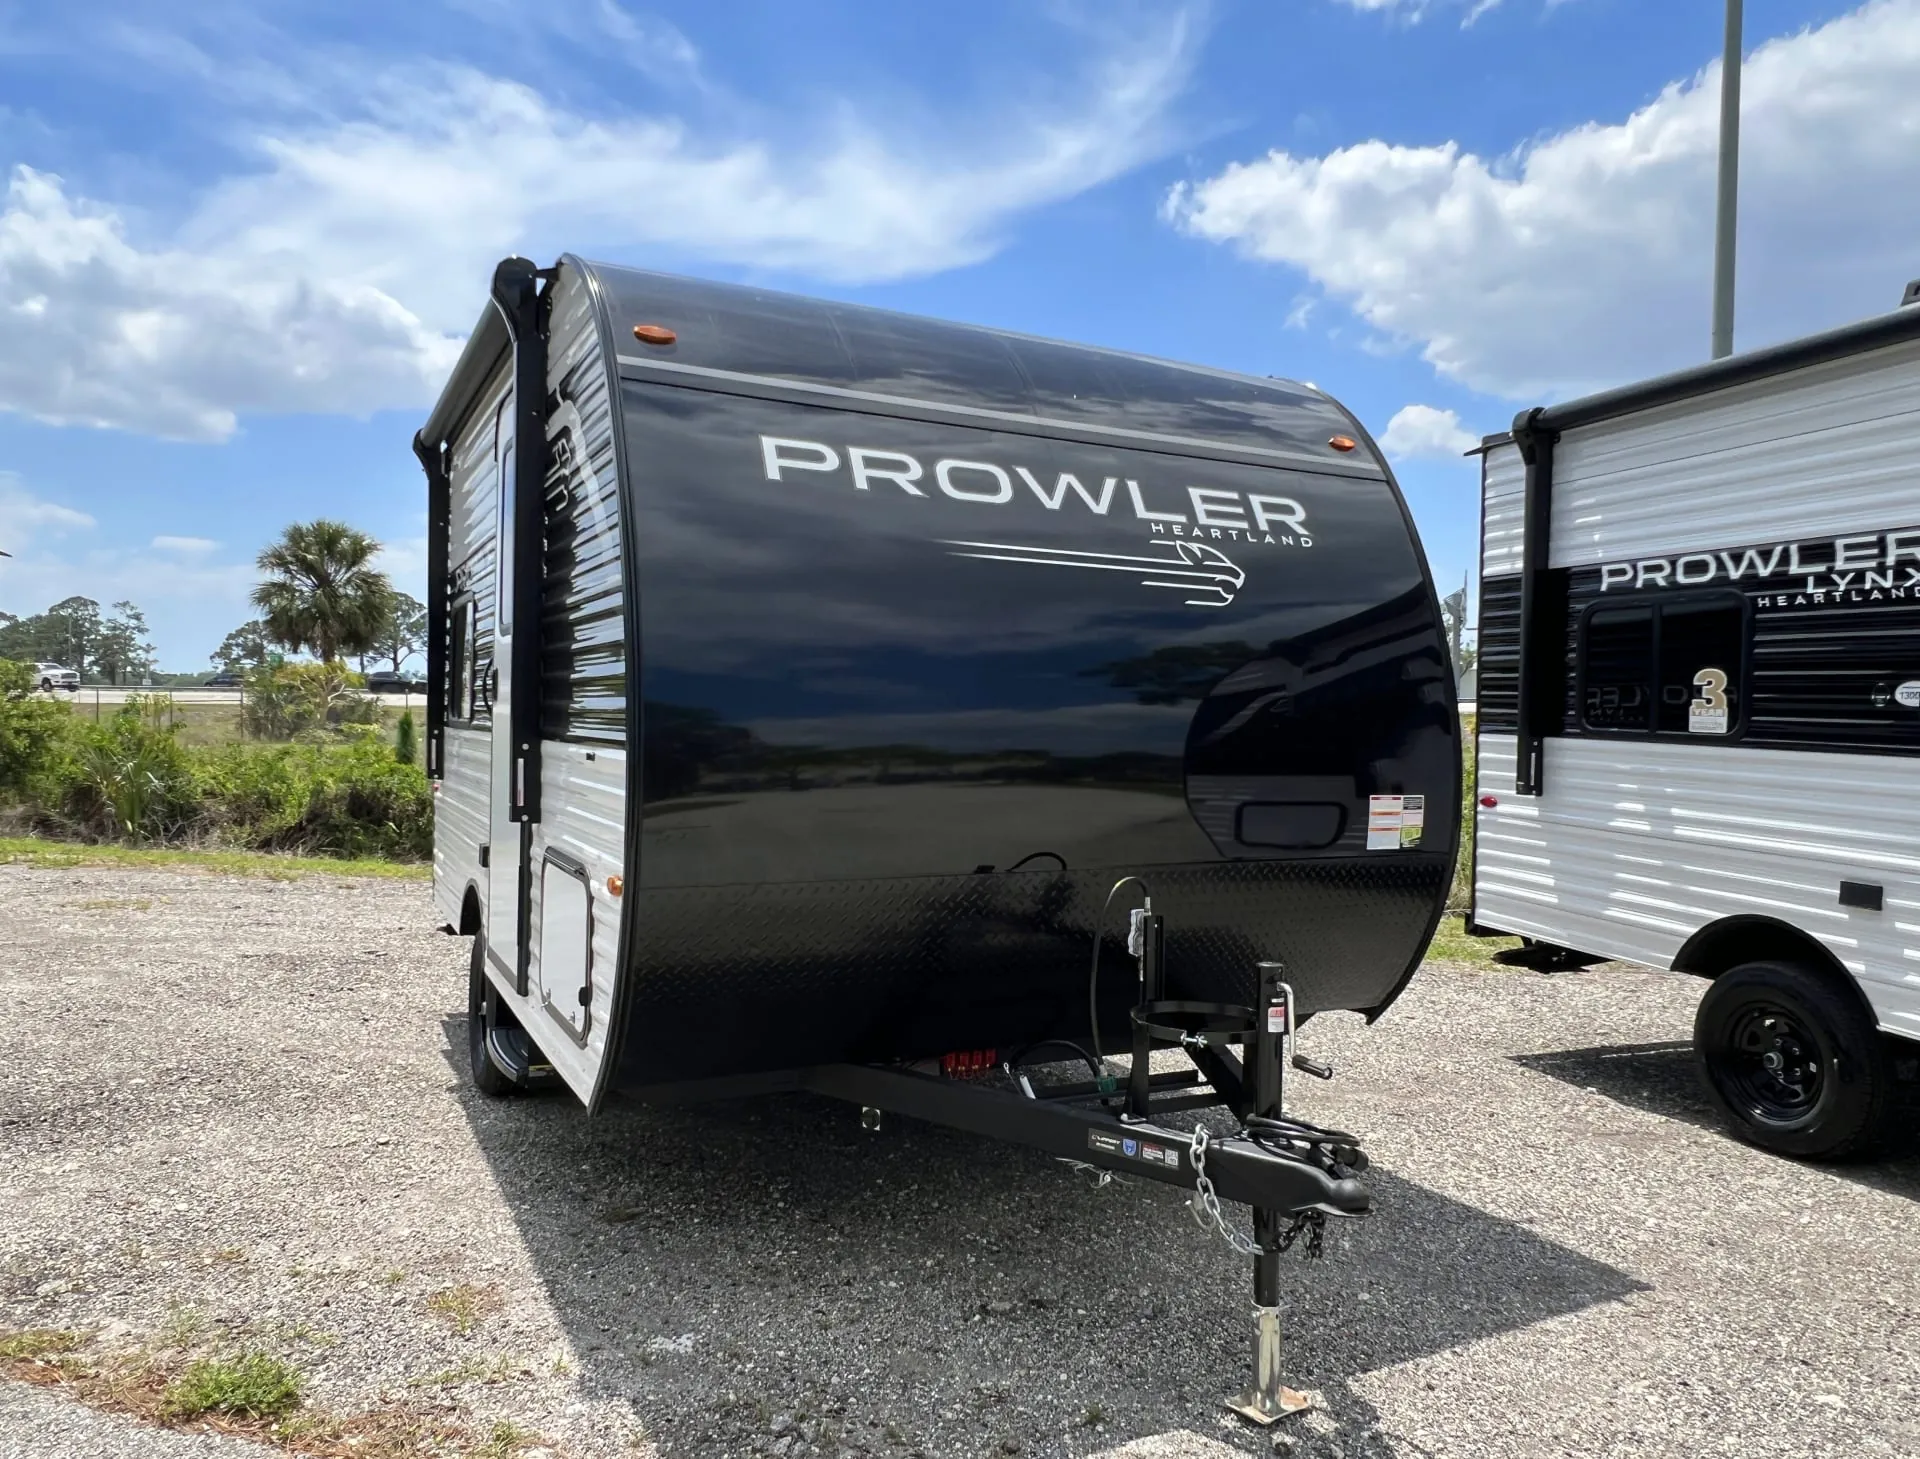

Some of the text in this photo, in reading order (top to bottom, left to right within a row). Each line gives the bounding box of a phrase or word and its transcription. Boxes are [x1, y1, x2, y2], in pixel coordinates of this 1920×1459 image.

[759, 434, 1314, 535] PROWLER
[1151, 523, 1313, 548] HEARTLAND
[1600, 530, 1920, 591] PROWLER
[1806, 567, 1920, 594] LYNX
[1692, 668, 1727, 709] 3
